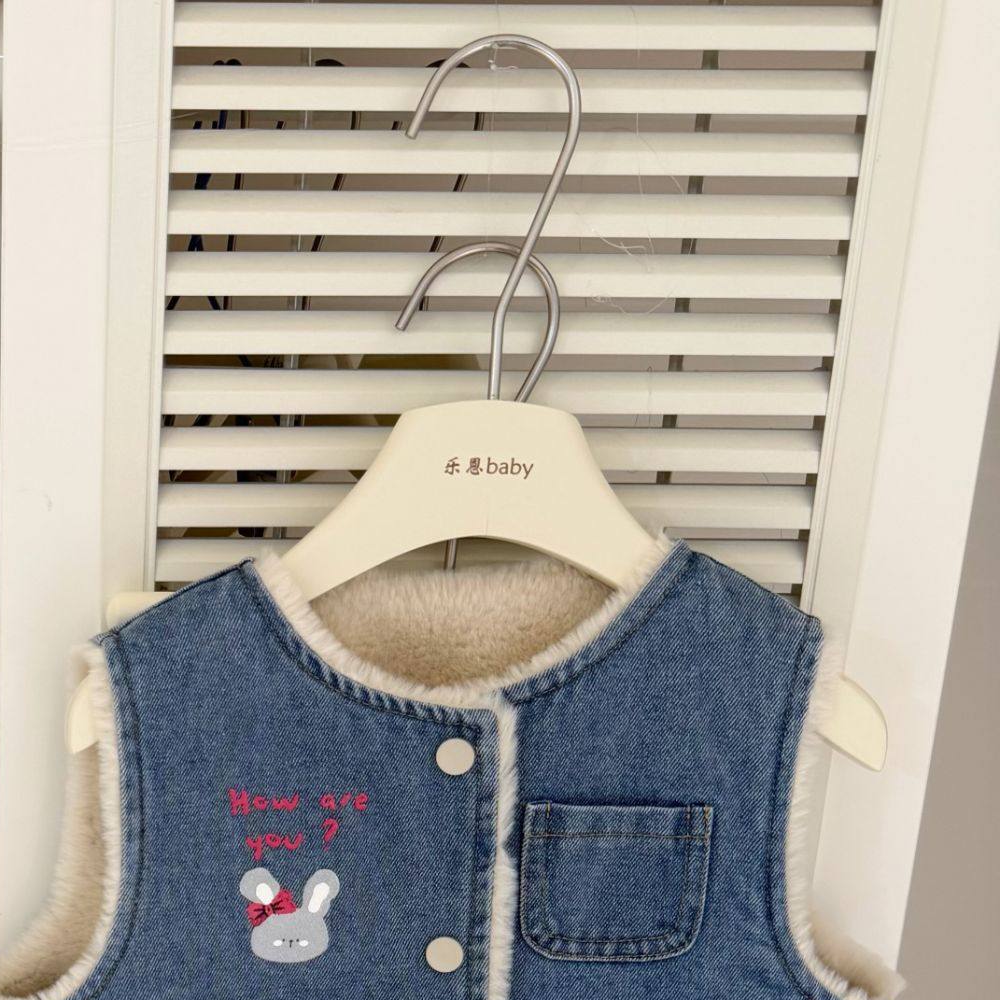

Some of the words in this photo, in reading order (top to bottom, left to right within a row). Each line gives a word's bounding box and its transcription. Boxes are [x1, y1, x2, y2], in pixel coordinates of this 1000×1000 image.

[444, 456, 534, 480] 乐恩baby
[228, 788, 299, 816] How
[319, 792, 368, 811] are
